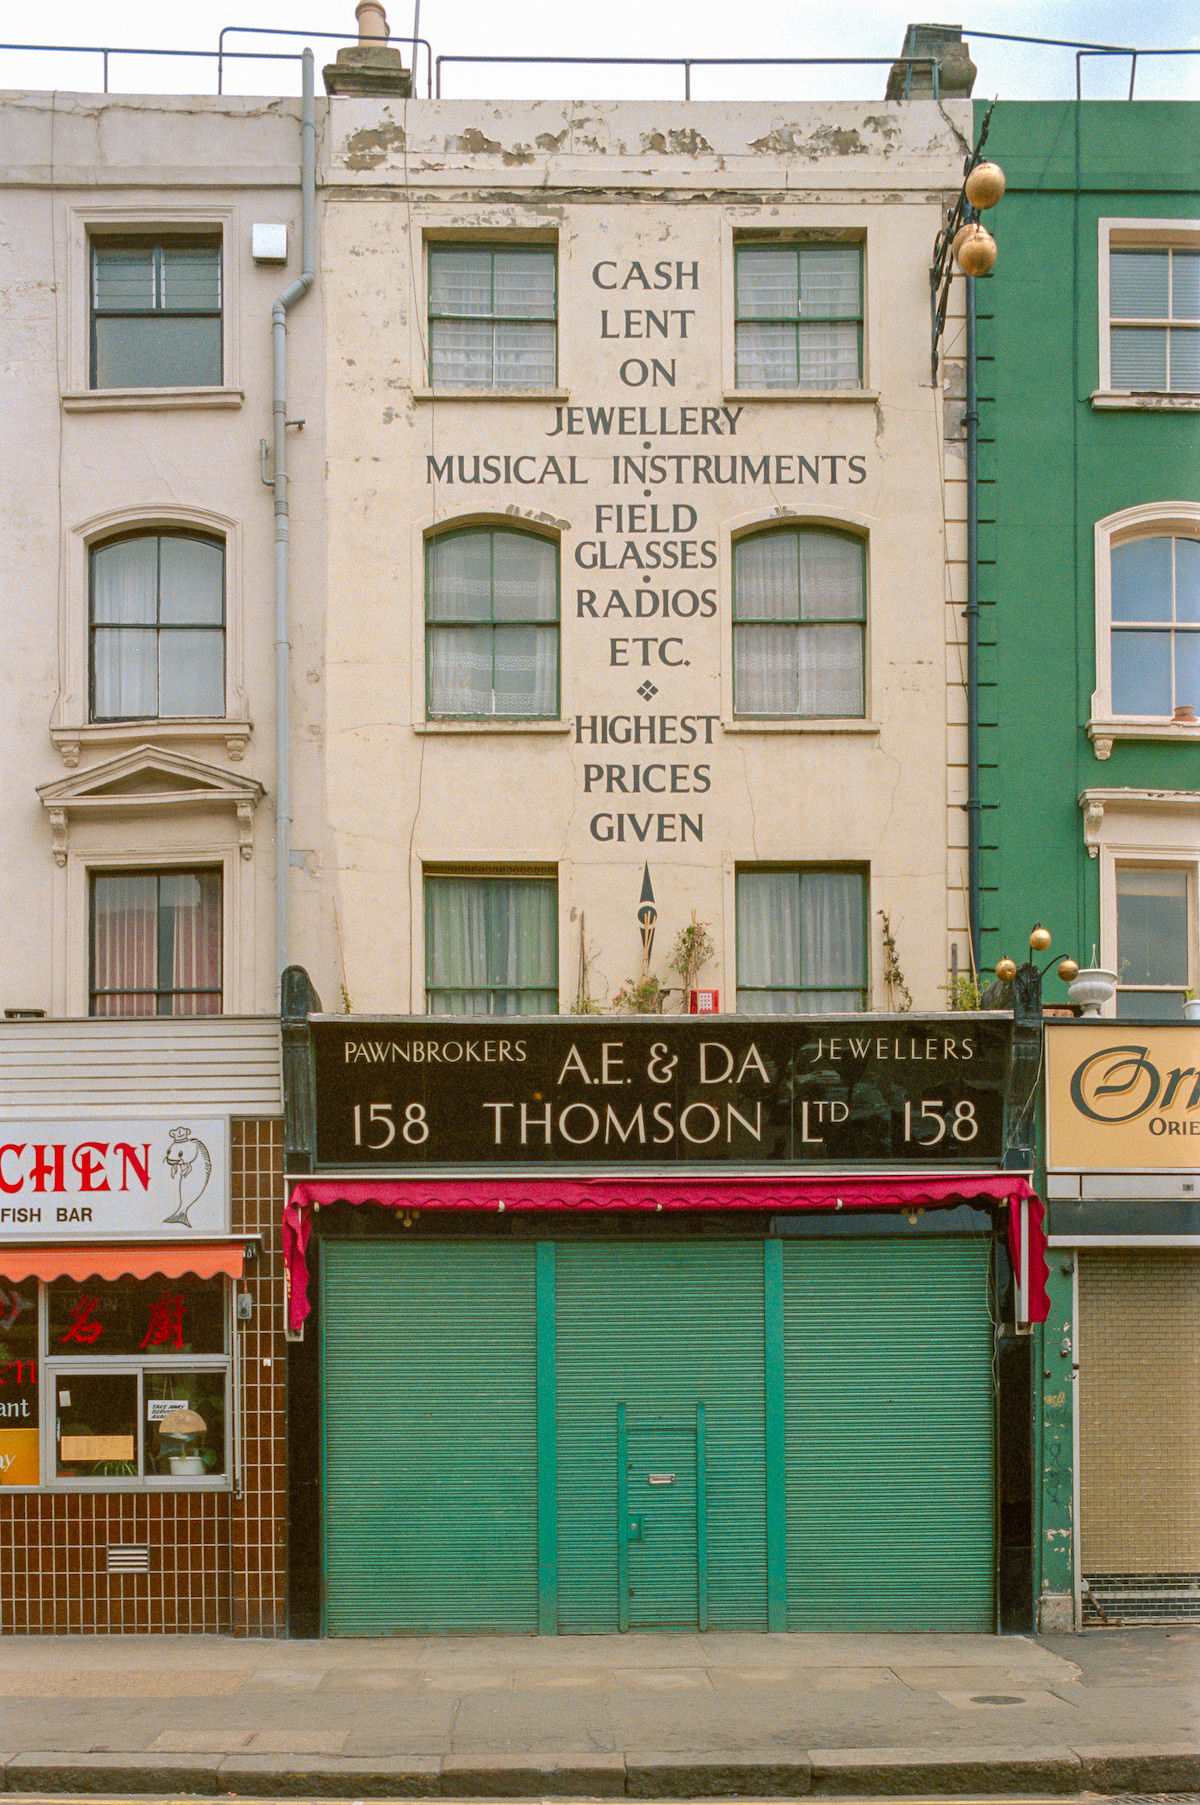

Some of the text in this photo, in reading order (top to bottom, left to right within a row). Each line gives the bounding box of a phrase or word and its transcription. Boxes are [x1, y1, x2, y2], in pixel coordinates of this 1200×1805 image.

[592, 261, 700, 291] CASH
[600, 309, 697, 340] LENT
[619, 358, 678, 388] ON
[545, 406, 744, 436] JEWELLERY
[427, 455, 868, 486] MUSICAL INSTRUMENTS
[595, 504, 699, 534] FIELD
[574, 540, 718, 571] GLASSES
[576, 589, 718, 619] RADIOS
[609, 637, 692, 668] ETC.
[575, 715, 721, 745] HIGHEST
[583, 763, 712, 795] PRICES
[589, 812, 704, 843] GIVEN
[344, 1040, 528, 1064] PAWNBROKERS
[647, 1042, 680, 1086] &
[811, 1038, 974, 1064] JEWELLERS
[353, 1103, 430, 1150] 158
[483, 1102, 764, 1145] THOMSON
[903, 1100, 979, 1147] 158
[0, 1142, 152, 1195] CHEN
[1, 1208, 93, 1223] FISH BAR
